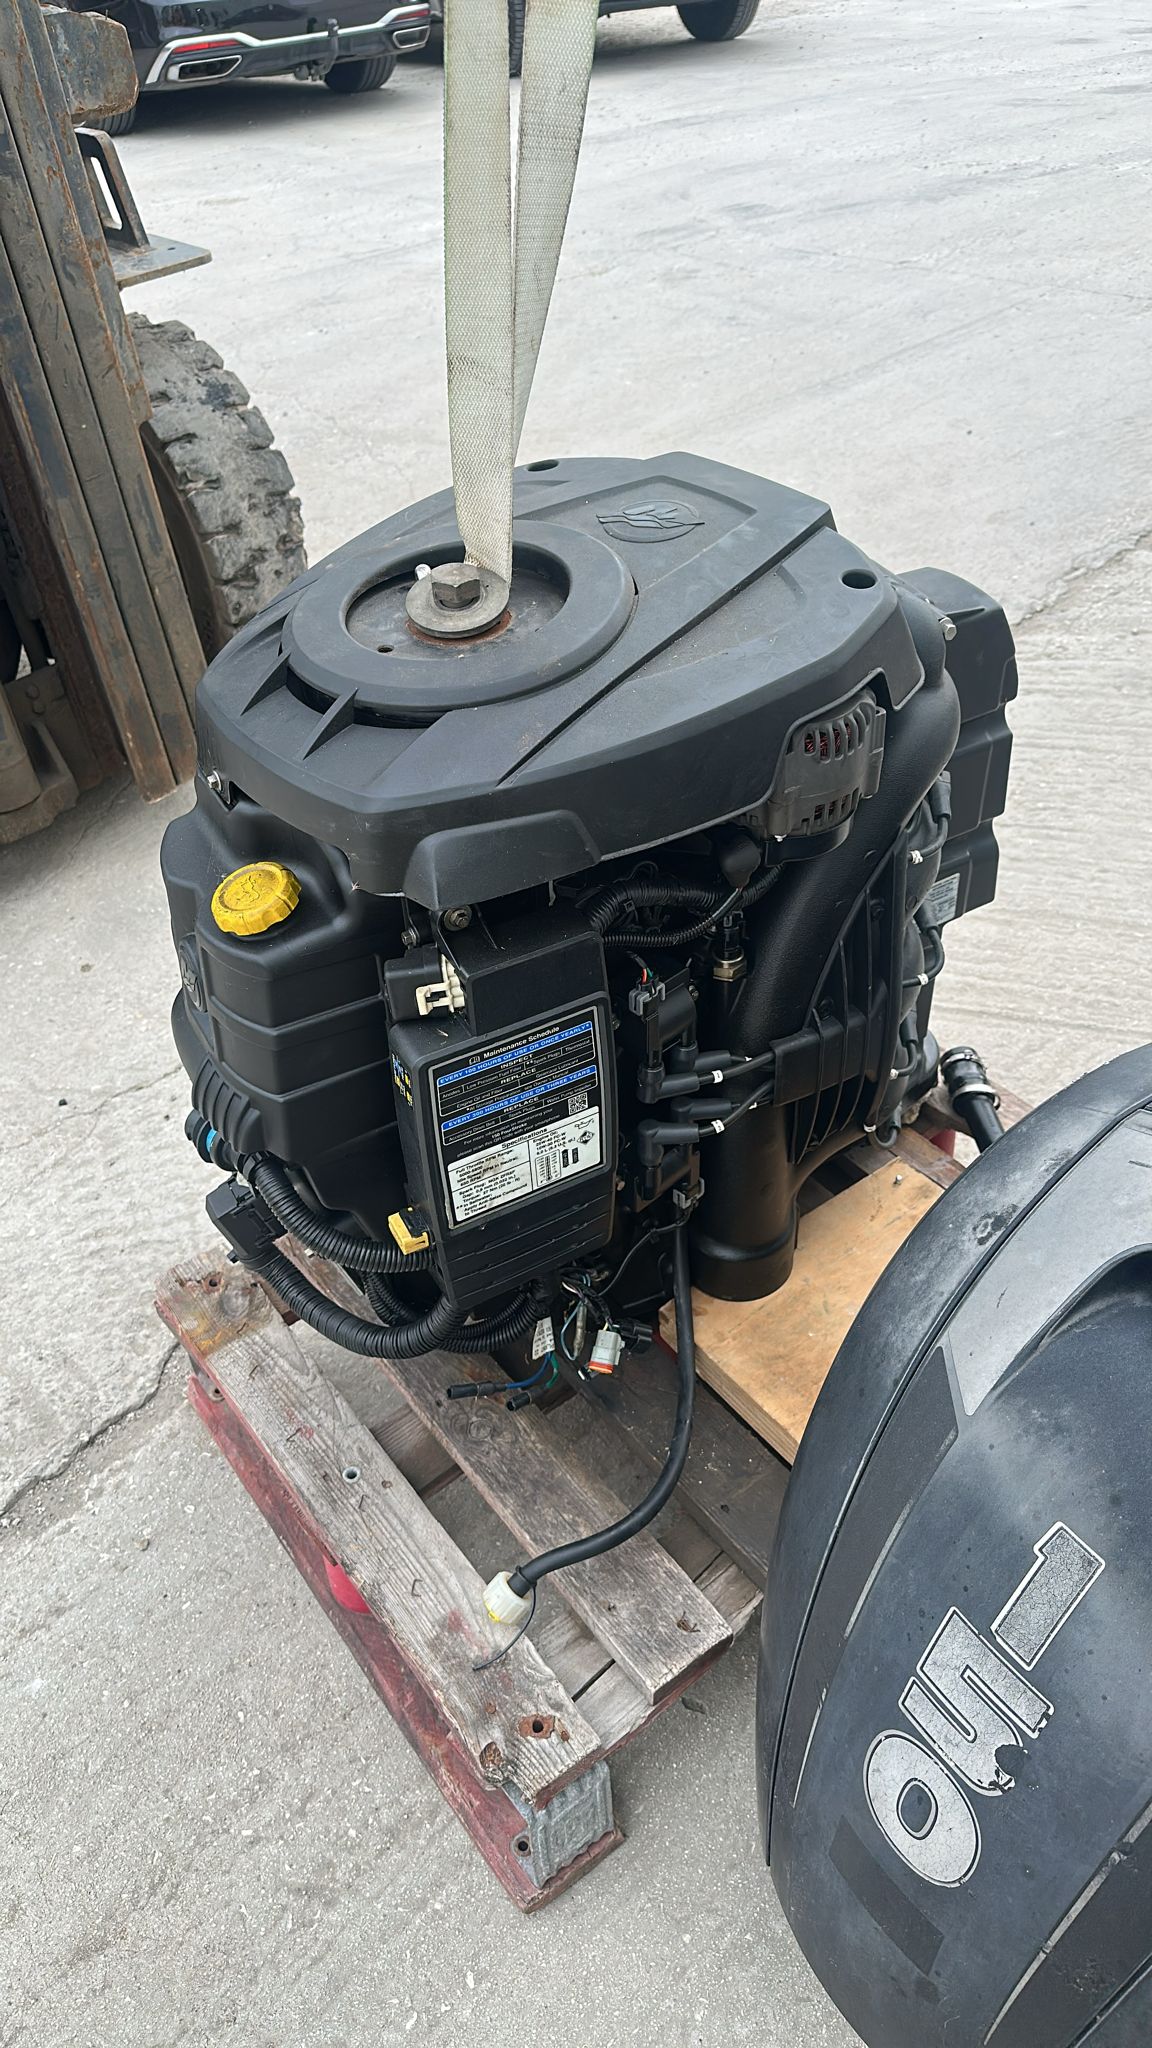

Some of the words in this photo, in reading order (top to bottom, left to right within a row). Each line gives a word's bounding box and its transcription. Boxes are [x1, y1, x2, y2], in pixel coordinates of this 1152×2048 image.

[482, 1037, 527, 1059] Maintenance
[527, 1024, 559, 1042] Schedule
[439, 1071, 463, 1084] EVERY
[464, 1066, 476, 1074] 100
[477, 1056, 502, 1070] HOURS
[502, 1052, 513, 1060] OF
[514, 1046, 528, 1056] USE
[528, 1042, 539, 1050] OR
[540, 1034, 559, 1046] ONCE
[500, 1052, 533, 1069] INSPECT
[500, 1067, 536, 1084] REPLACE
[448, 1114, 471, 1126] EVERY
[472, 1109, 483, 1117] 300
[484, 1100, 508, 1113] HOURS
[509, 1095, 519, 1103] OF
[520, 1090, 533, 1099] USE
[534, 1085, 545, 1093] OR
[546, 1077, 567, 1089] THREE
[568, 1068, 591, 1080] YEARS
[503, 1096, 539, 1113] REPLACE
[501, 1127, 547, 1149] Specifications
[532, 1133, 549, 1143] Engine
[862, 1520, 1106, 1889] 150
